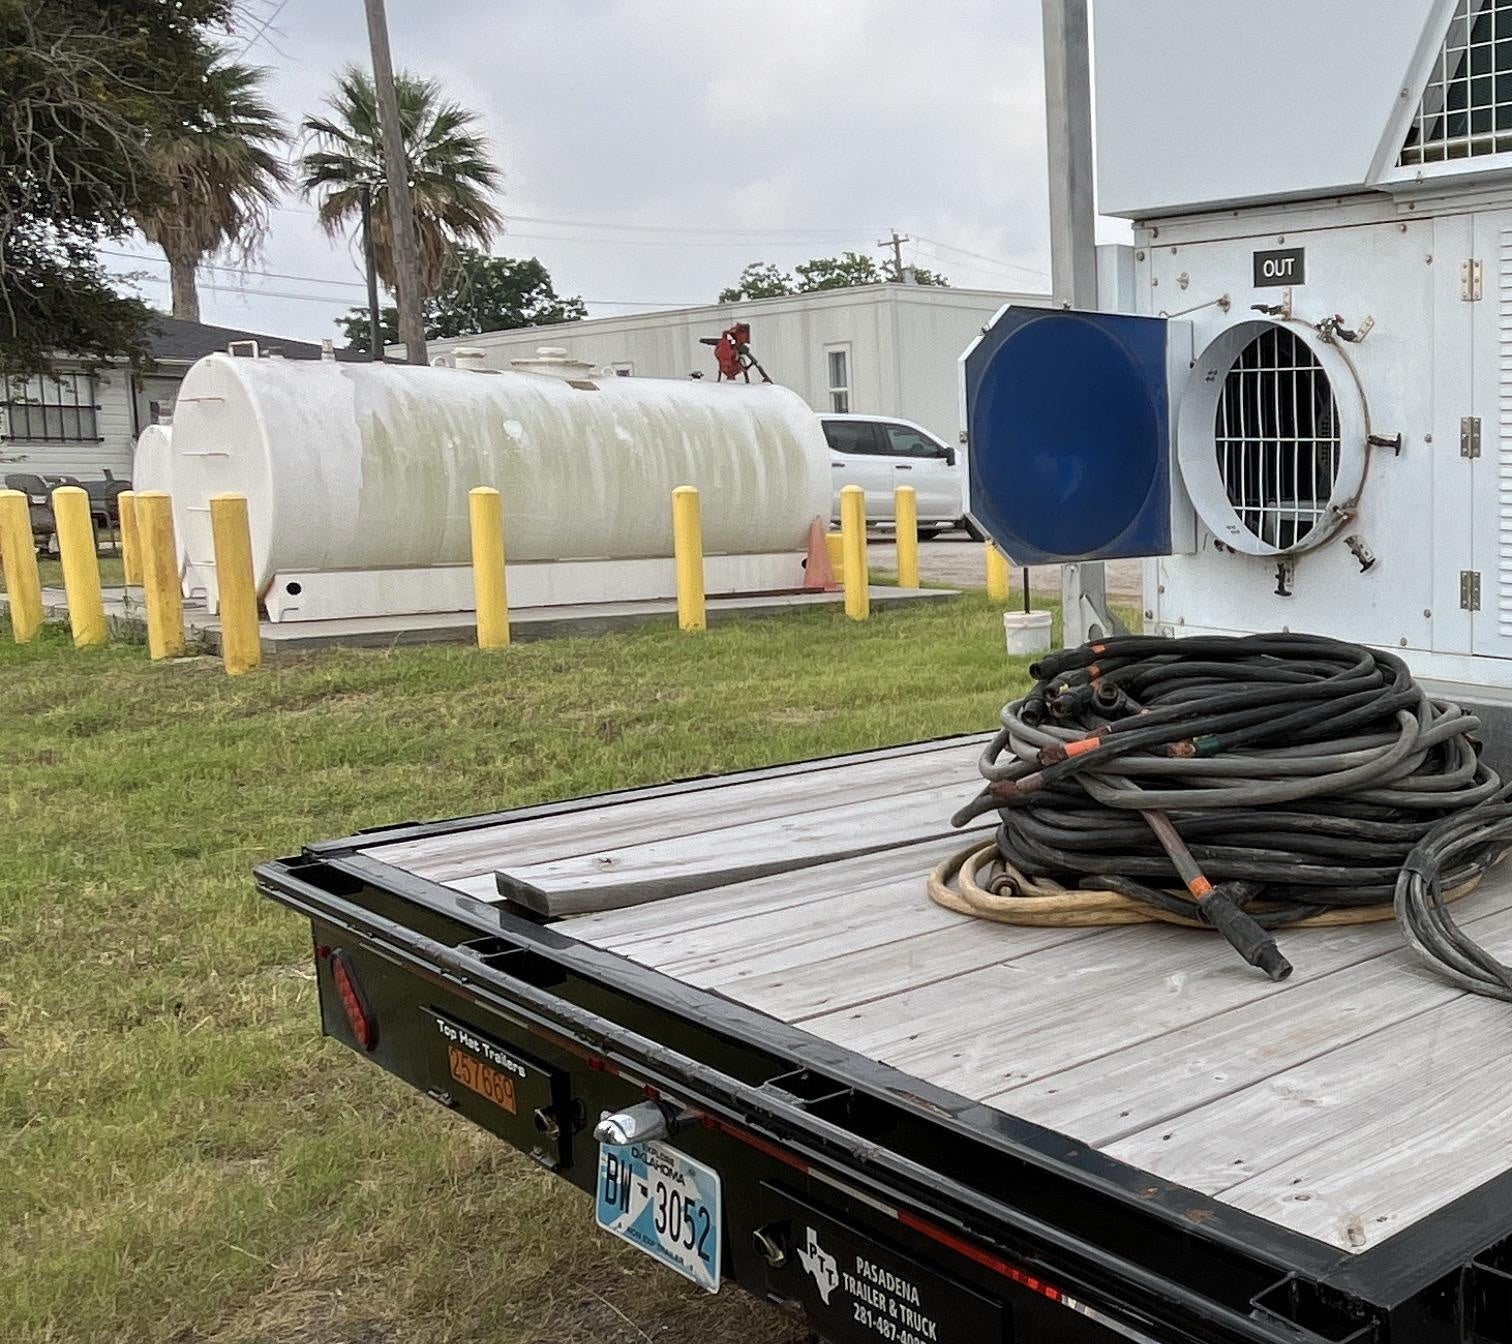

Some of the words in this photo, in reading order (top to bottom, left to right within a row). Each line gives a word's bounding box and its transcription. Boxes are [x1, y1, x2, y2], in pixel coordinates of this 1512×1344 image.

[1263, 257, 1295, 278] OUT
[436, 1018, 457, 1041] Top
[458, 1029, 480, 1053] Hat
[482, 1042, 527, 1078] Trailers
[842, 1271, 887, 1312] TRAILER
[888, 1297, 898, 1319] &
[899, 1303, 937, 1342] TRUCK
[855, 1255, 921, 1307] PASADENA
